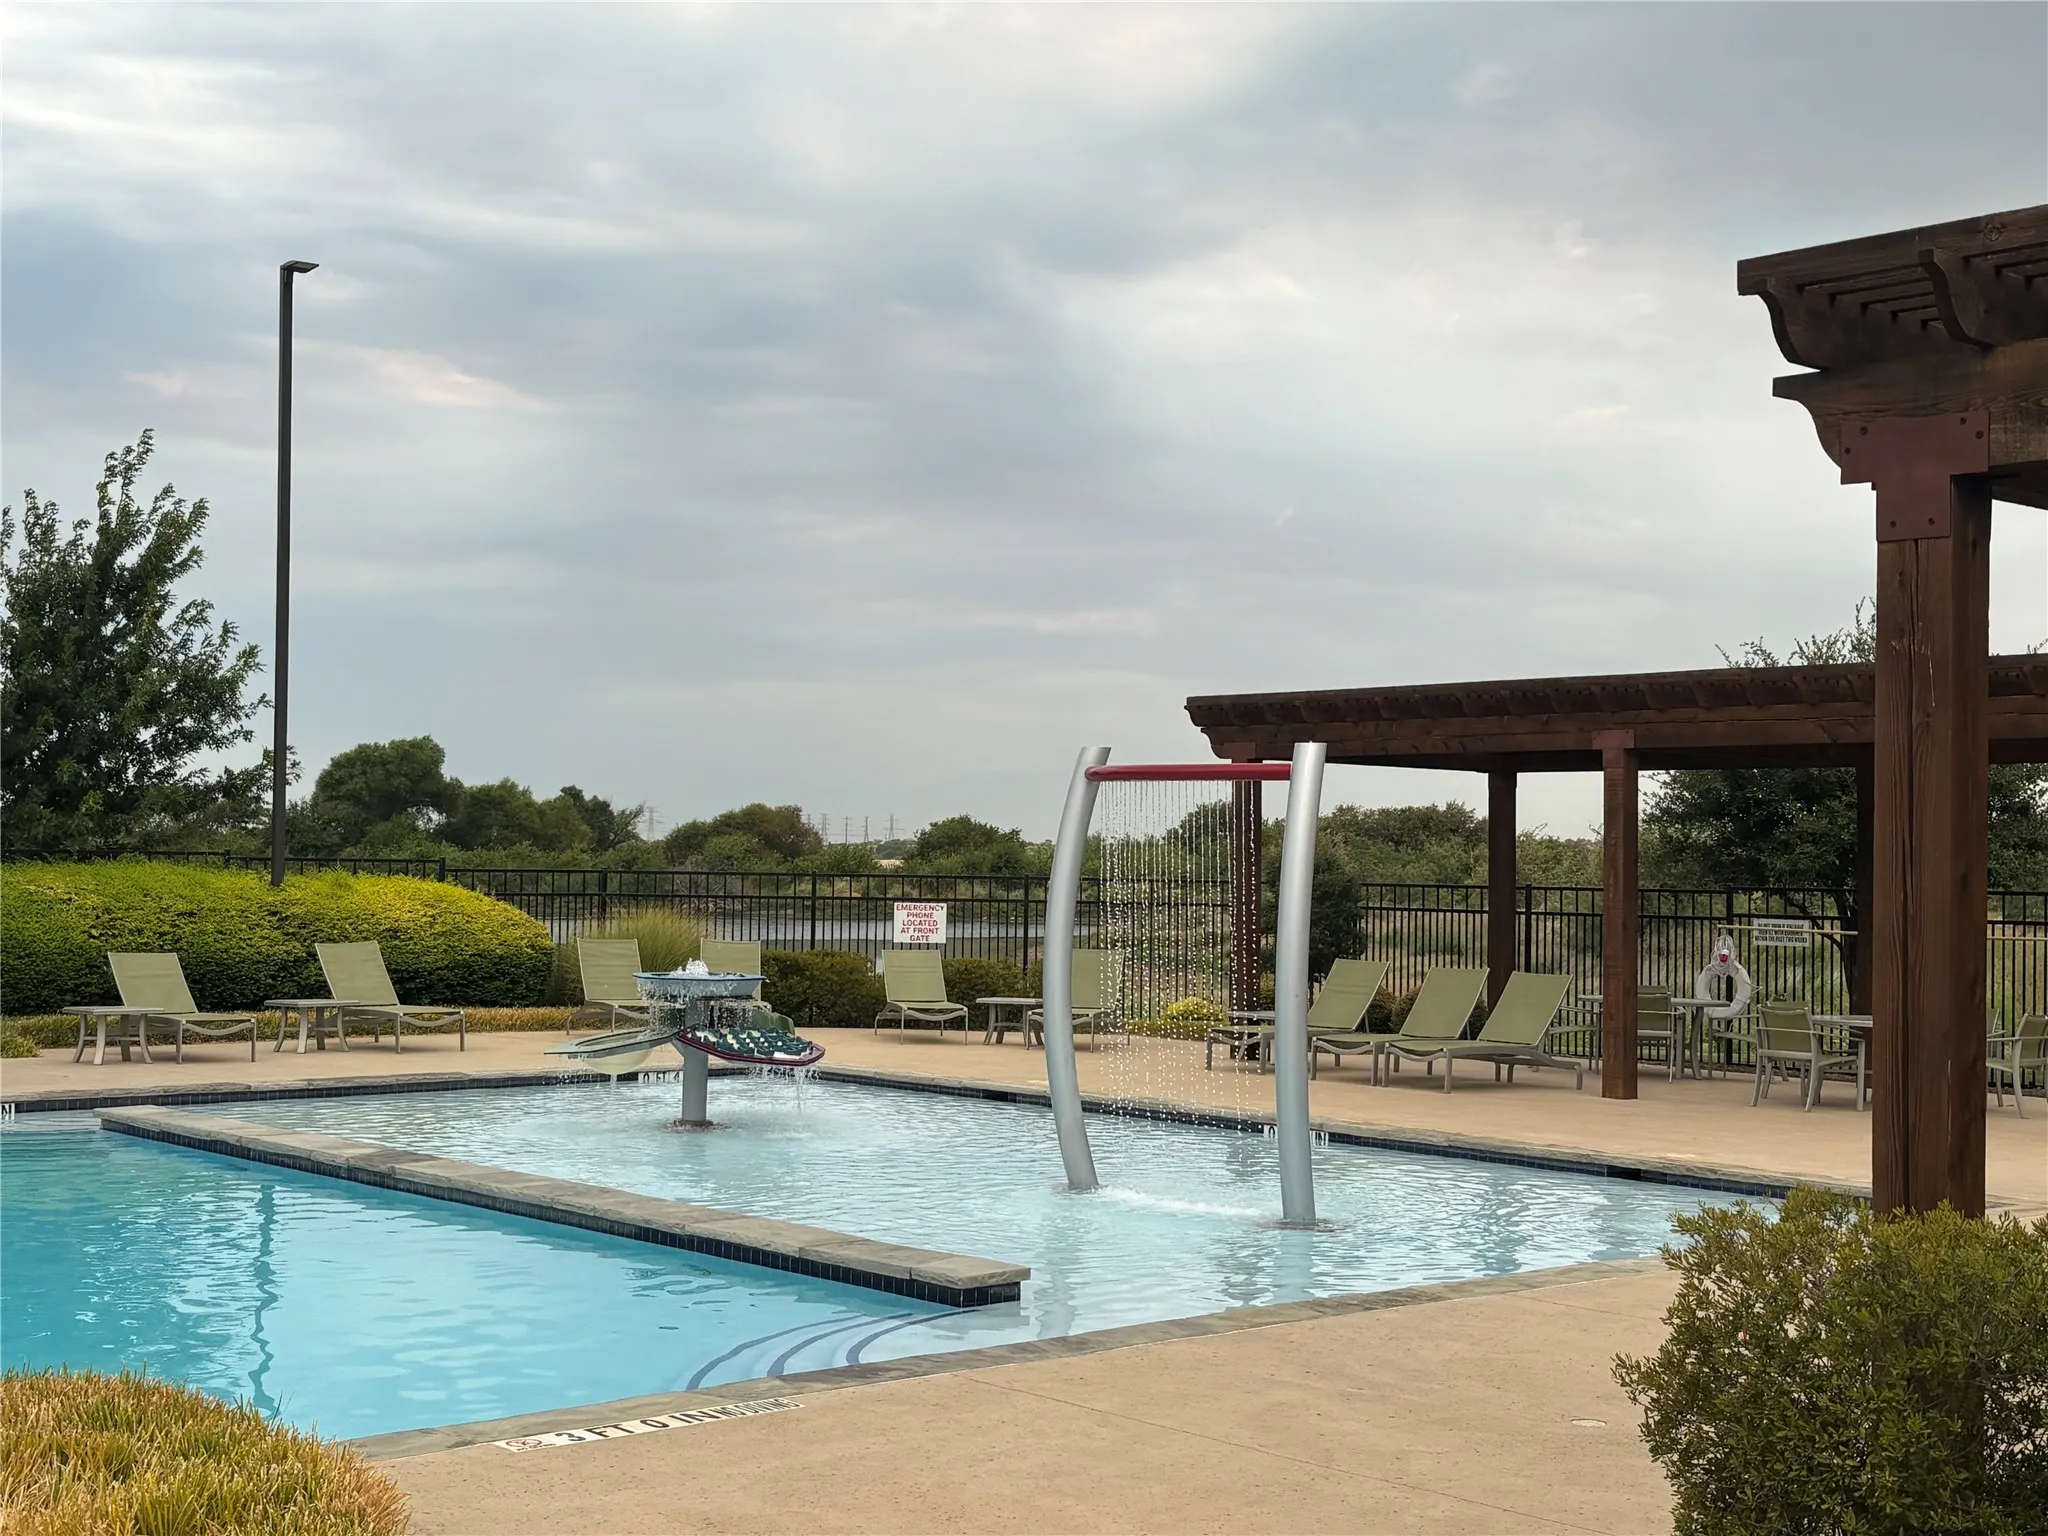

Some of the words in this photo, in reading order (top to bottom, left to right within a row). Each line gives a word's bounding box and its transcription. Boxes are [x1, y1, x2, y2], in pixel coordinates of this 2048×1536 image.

[555, 1432, 587, 1442] 3
[583, 1423, 635, 1438] FT
[668, 1410, 722, 1424] IN
